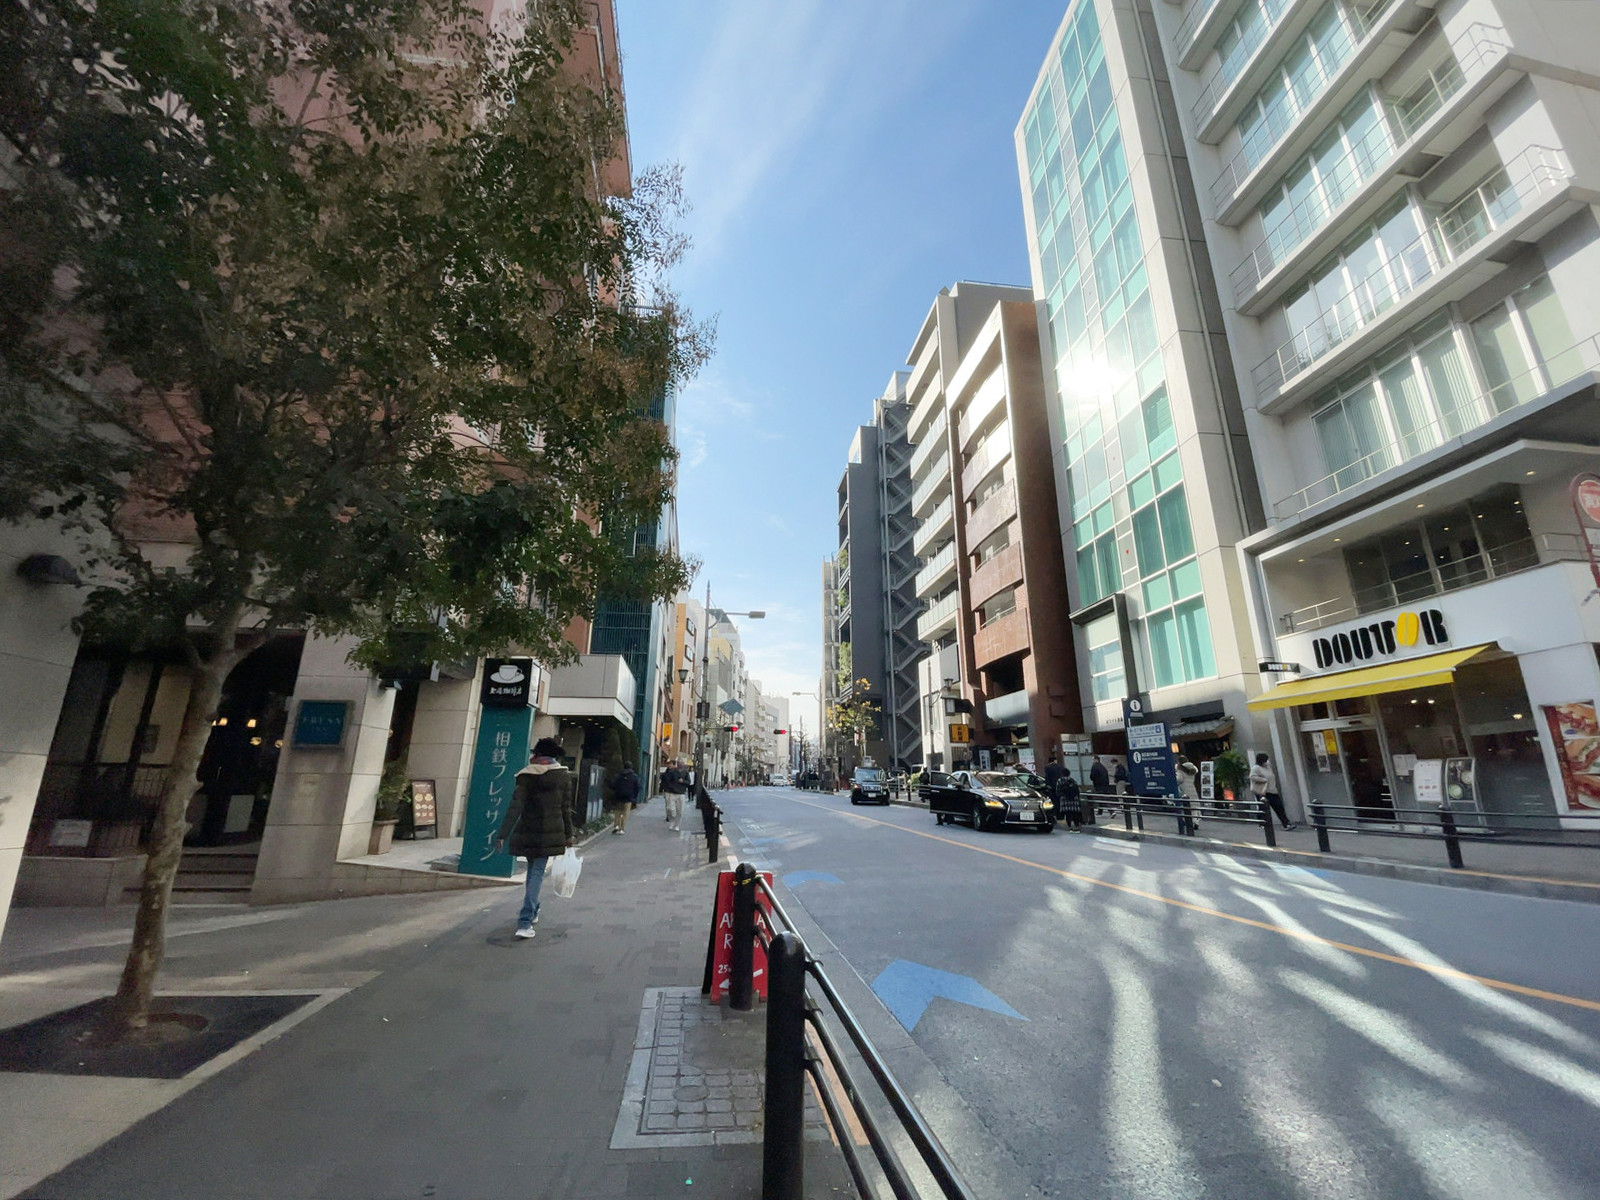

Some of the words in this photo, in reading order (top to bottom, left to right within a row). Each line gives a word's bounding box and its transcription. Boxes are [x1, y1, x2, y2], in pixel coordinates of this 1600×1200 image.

[1313, 608, 1448, 669] DOUTOR
[480, 731, 511, 861] 相鉄フレッサイン
